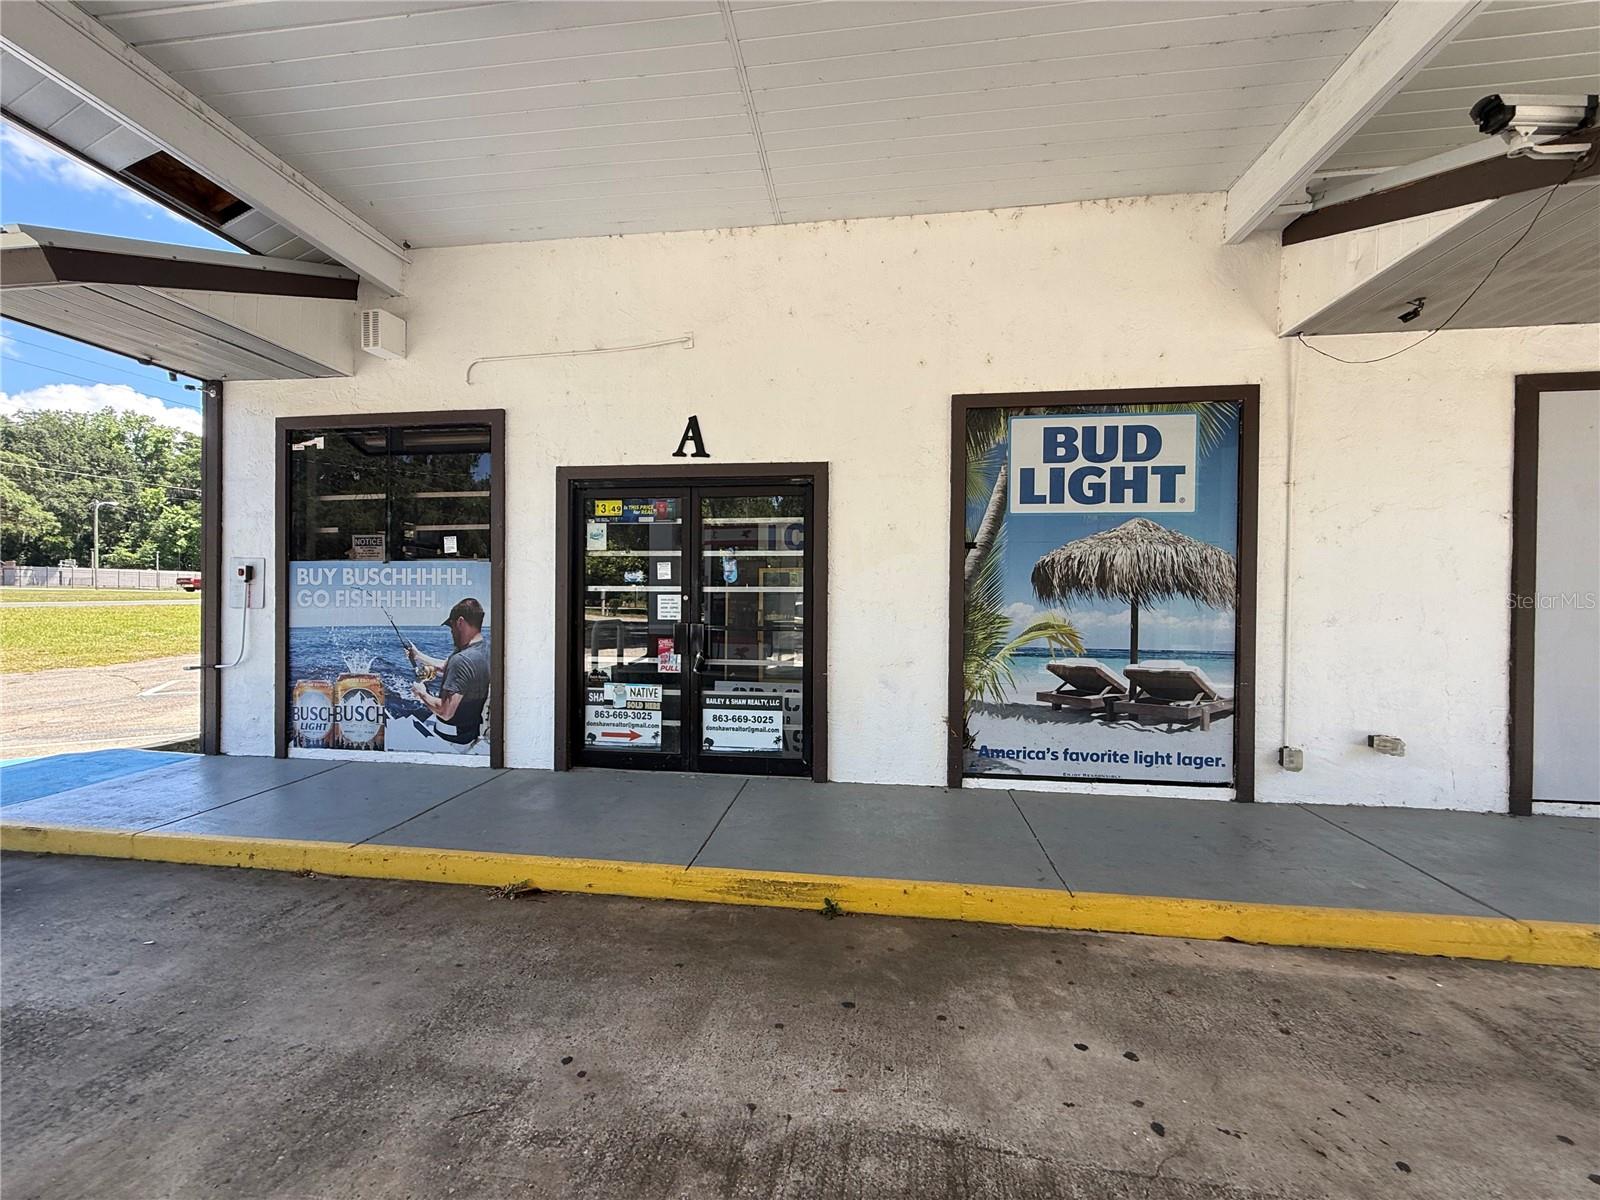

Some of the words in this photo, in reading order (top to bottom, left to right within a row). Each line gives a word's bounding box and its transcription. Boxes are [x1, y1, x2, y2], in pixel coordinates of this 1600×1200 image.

[672, 414, 711, 458] A
[1042, 424, 1162, 464] BUD
[1019, 465, 1186, 505] LIGHT
[354, 538, 382, 546] NOTICE
[296, 568, 337, 586] BUY
[297, 589, 330, 608] GO
[630, 687, 658, 698] NATIVE
[706, 697, 724, 705] BAILEY
[731, 698, 746, 706] SHAW
[747, 699, 768, 707] REALTY,
[293, 706, 334, 722] BUSCH
[335, 704, 385, 724] BUSCH
[594, 710, 652, 720] 863-669-3025
[712, 714, 774, 724] 863-669-3025
[300, 722, 327, 731] LIGHT
[1063, 747, 1130, 765] favorite
[1133, 749, 1173, 768] light
[1176, 752, 1226, 769] lager.
